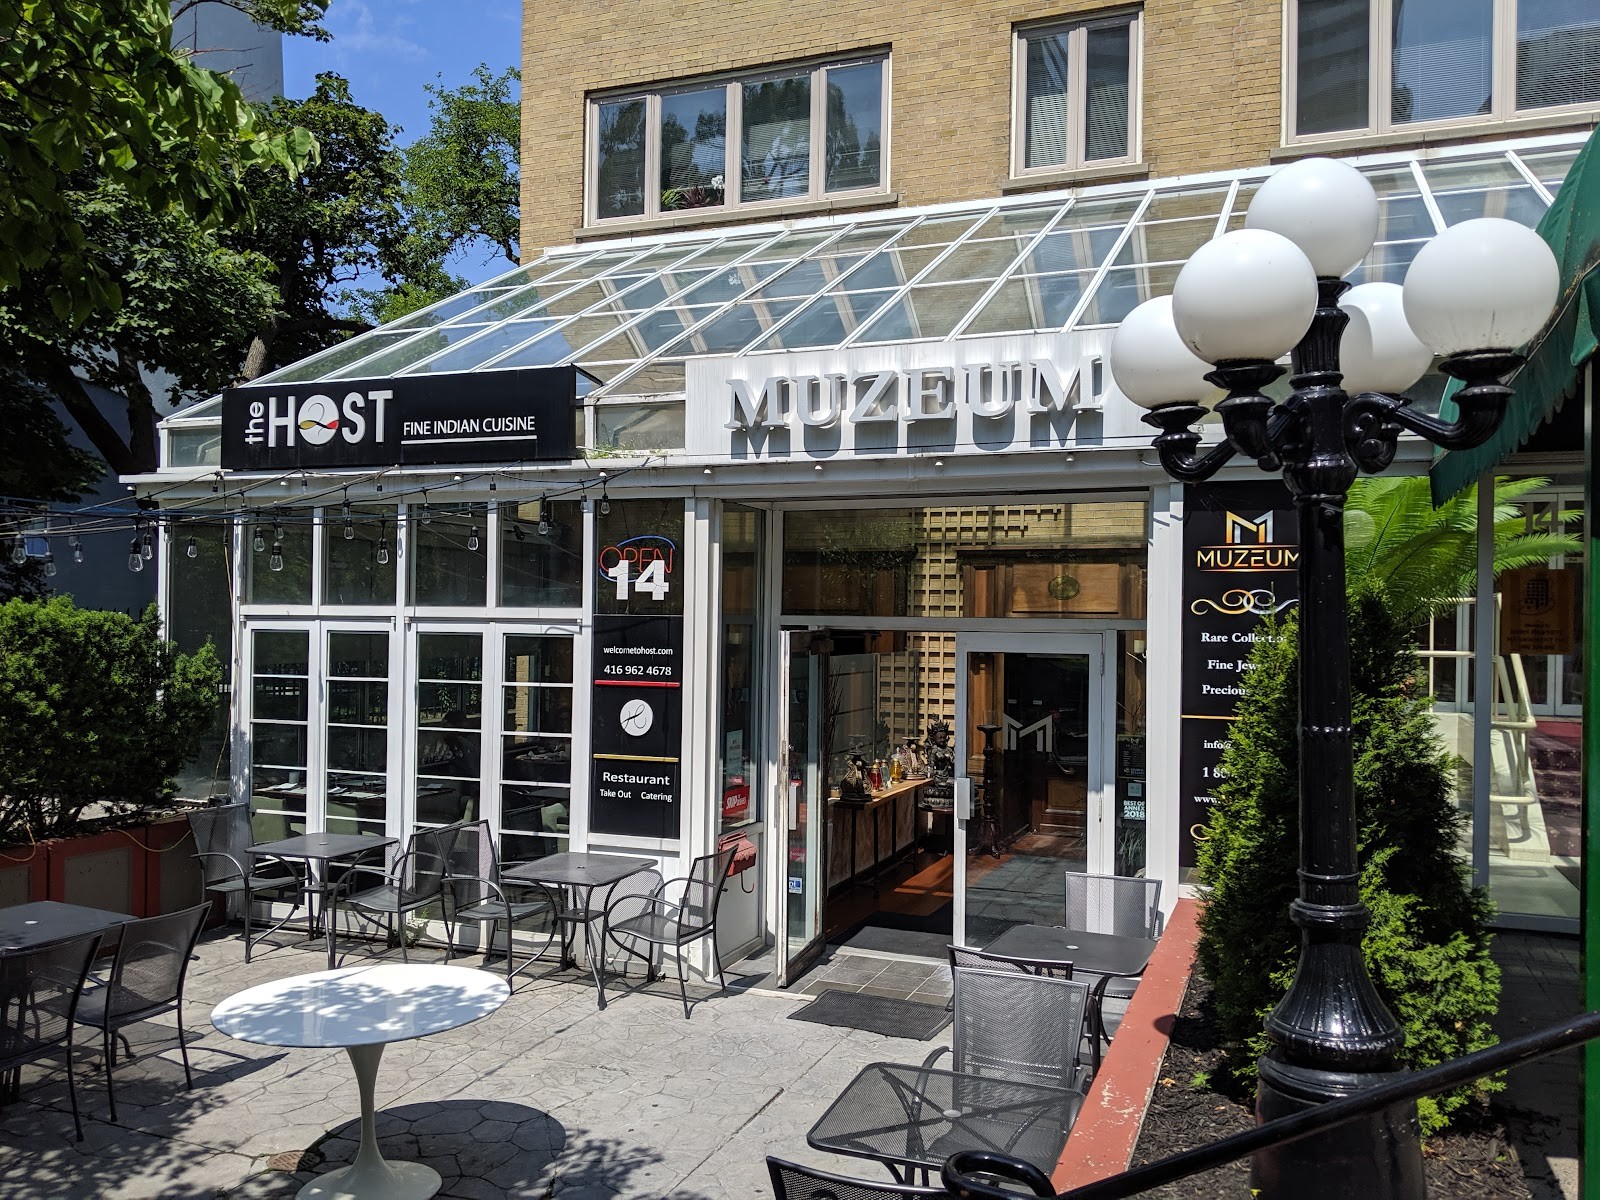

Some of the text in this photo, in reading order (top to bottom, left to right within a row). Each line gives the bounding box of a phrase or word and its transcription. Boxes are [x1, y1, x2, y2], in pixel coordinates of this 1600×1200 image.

[724, 354, 1105, 430] MUZEUM
[245, 390, 393, 448] the HOST
[403, 416, 535, 436] FINE INDIAN CUISINE
[600, 546, 673, 574] OPEN
[1197, 549, 1299, 567] MUZEUM
[608, 559, 669, 600] 14
[1201, 632, 1228, 643] Rare
[603, 645, 673, 655] welcometohost.com
[604, 664, 672, 676] 416 962 4678
[1207, 659, 1234, 670] Fine
[602, 771, 670, 785] Restaurant
[1202, 766, 1209, 778] 1
[600, 788, 672, 802] Take Out Catering
[1123, 810, 1145, 818] 2018
